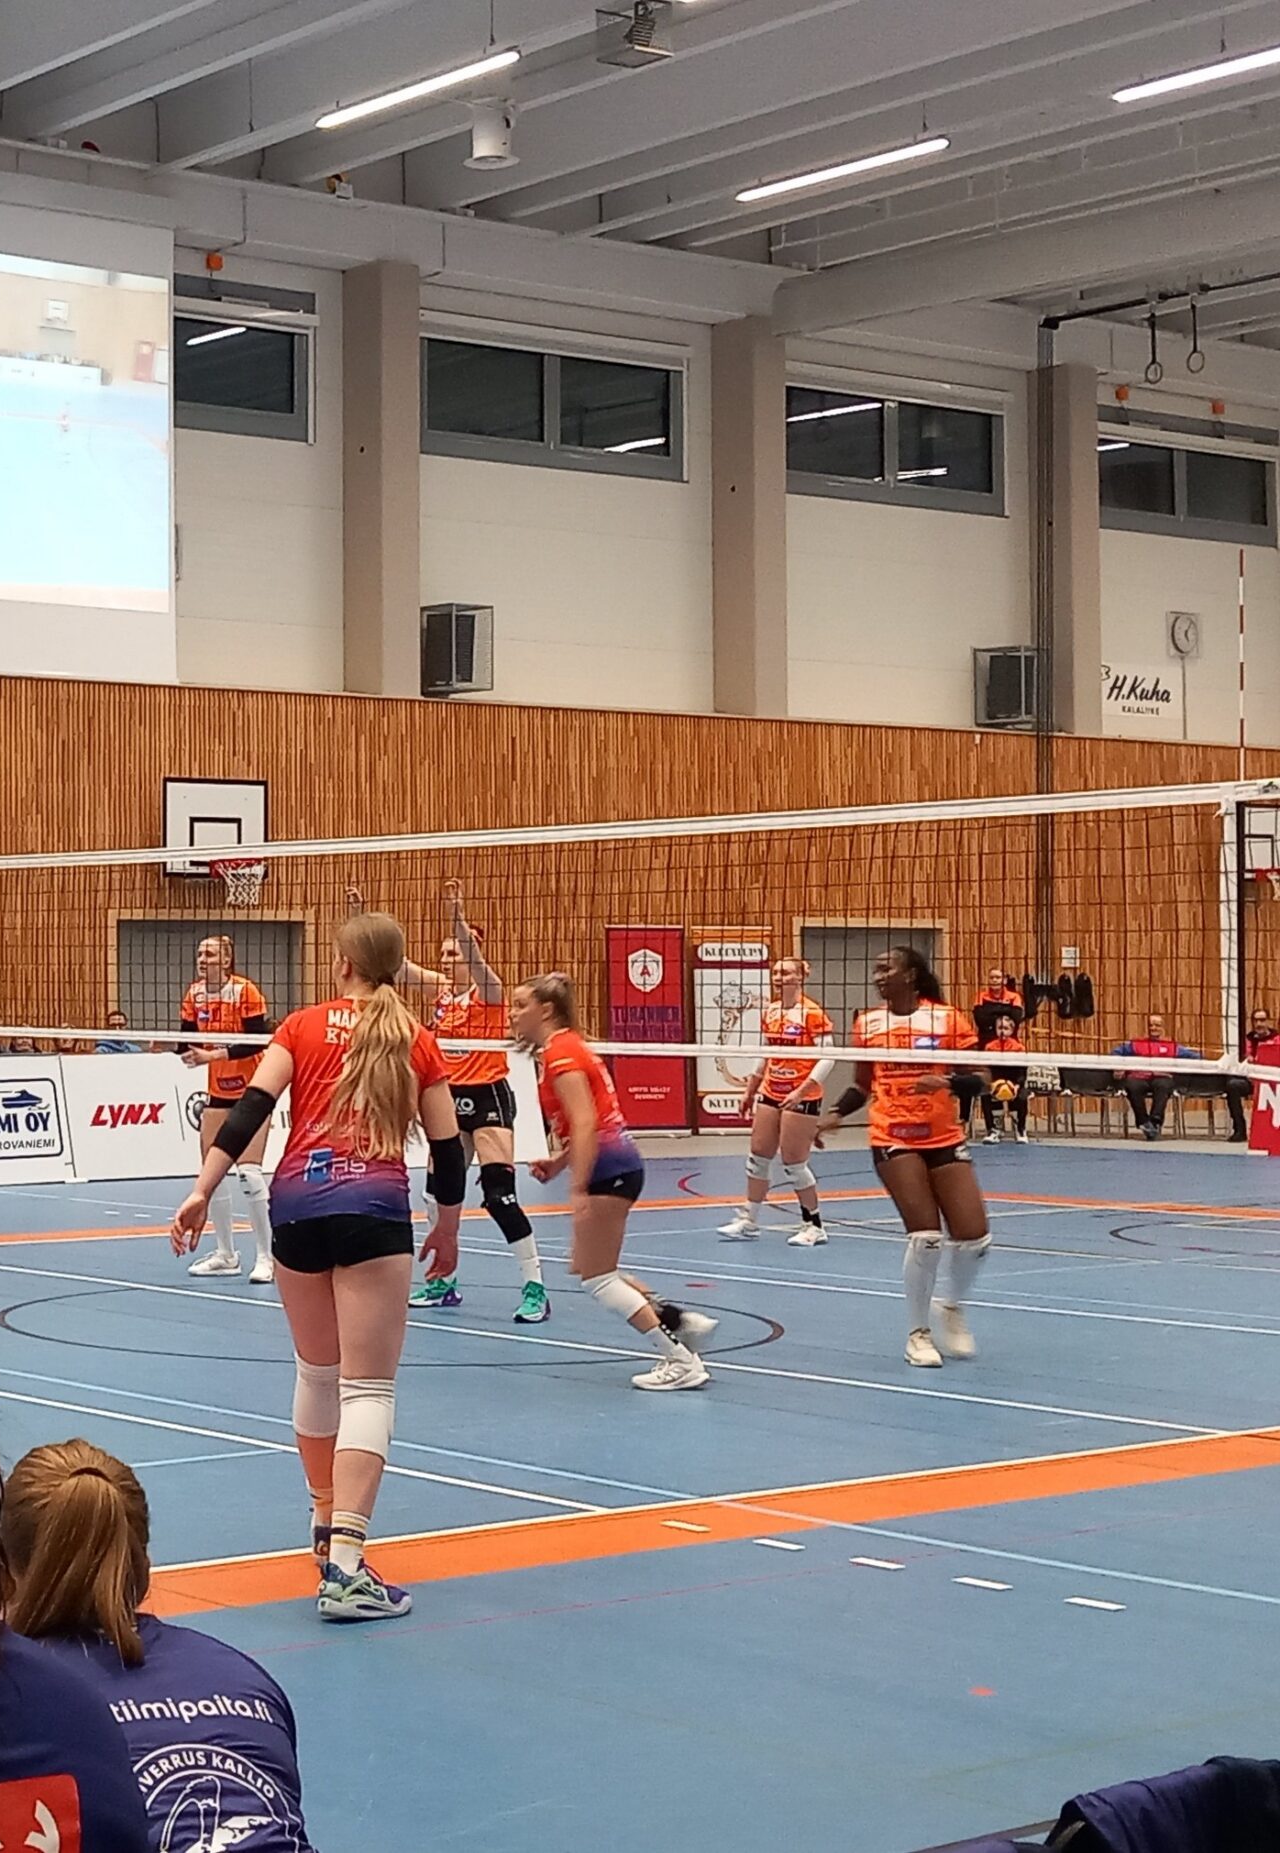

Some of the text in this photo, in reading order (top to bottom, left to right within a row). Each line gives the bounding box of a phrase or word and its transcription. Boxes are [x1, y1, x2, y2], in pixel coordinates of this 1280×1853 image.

[25, 1112, 50, 1132] OY
[90, 1103, 166, 1128] LYNX
[109, 1693, 273, 1724] tiimipaita.fi
[138, 1751, 275, 1799] VERRUS KALLIO
